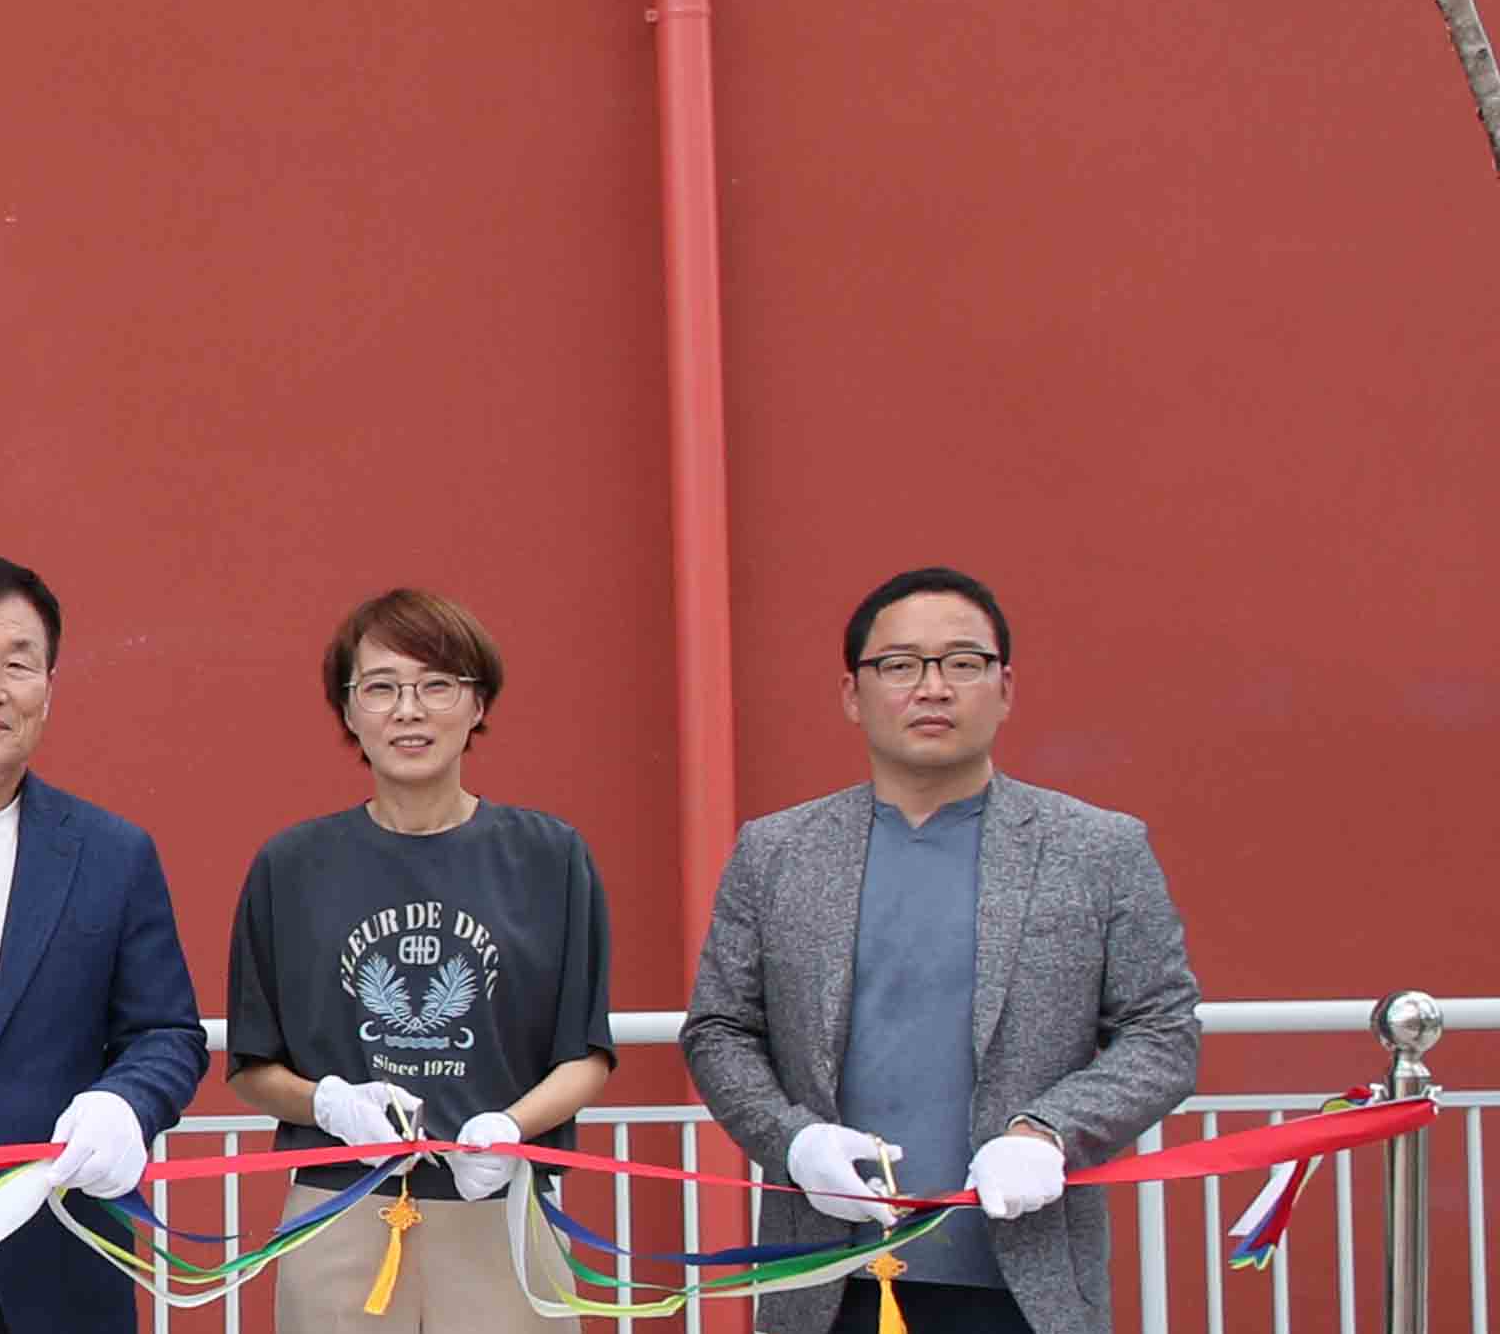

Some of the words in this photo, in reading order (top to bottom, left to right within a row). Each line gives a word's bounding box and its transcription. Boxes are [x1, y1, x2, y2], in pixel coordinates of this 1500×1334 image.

[405, 900, 443, 930] DE
[371, 1053, 419, 1076] Since
[424, 1059, 467, 1077] 1978
